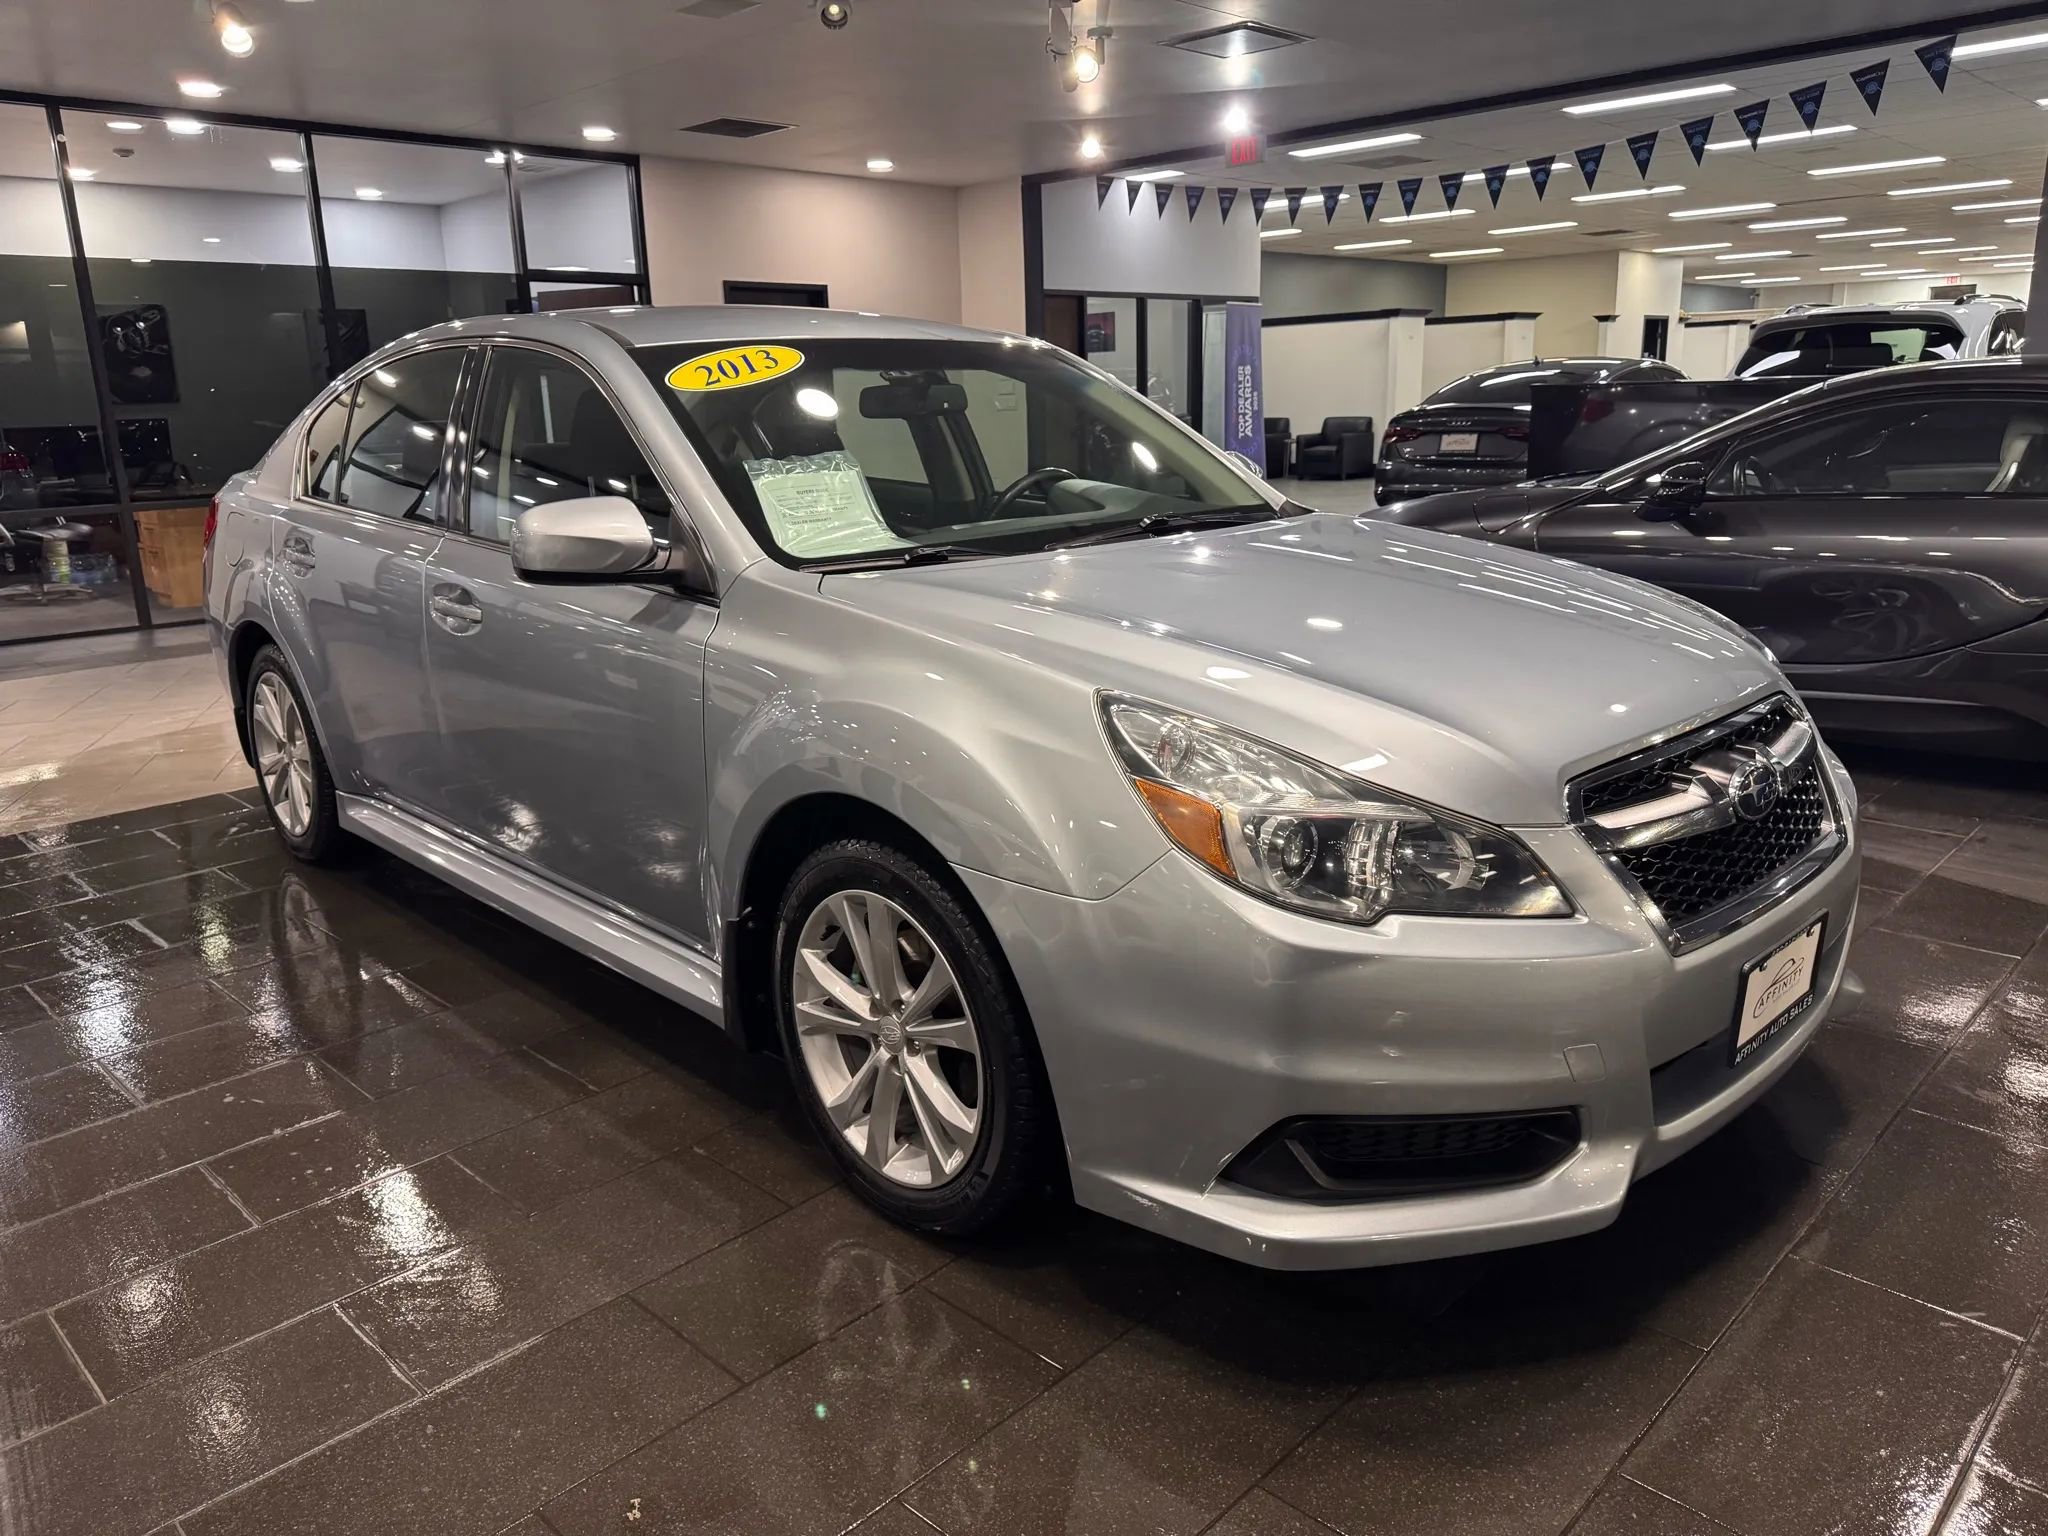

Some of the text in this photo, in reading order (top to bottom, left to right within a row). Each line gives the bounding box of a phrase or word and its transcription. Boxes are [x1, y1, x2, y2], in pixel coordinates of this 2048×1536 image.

[695, 350, 779, 387] 2013
[1244, 364, 1253, 437] AWARDS
[1758, 966, 1804, 1006] AFFINITY
[1734, 994, 1814, 1065] AFFINITY AUTO SALES
